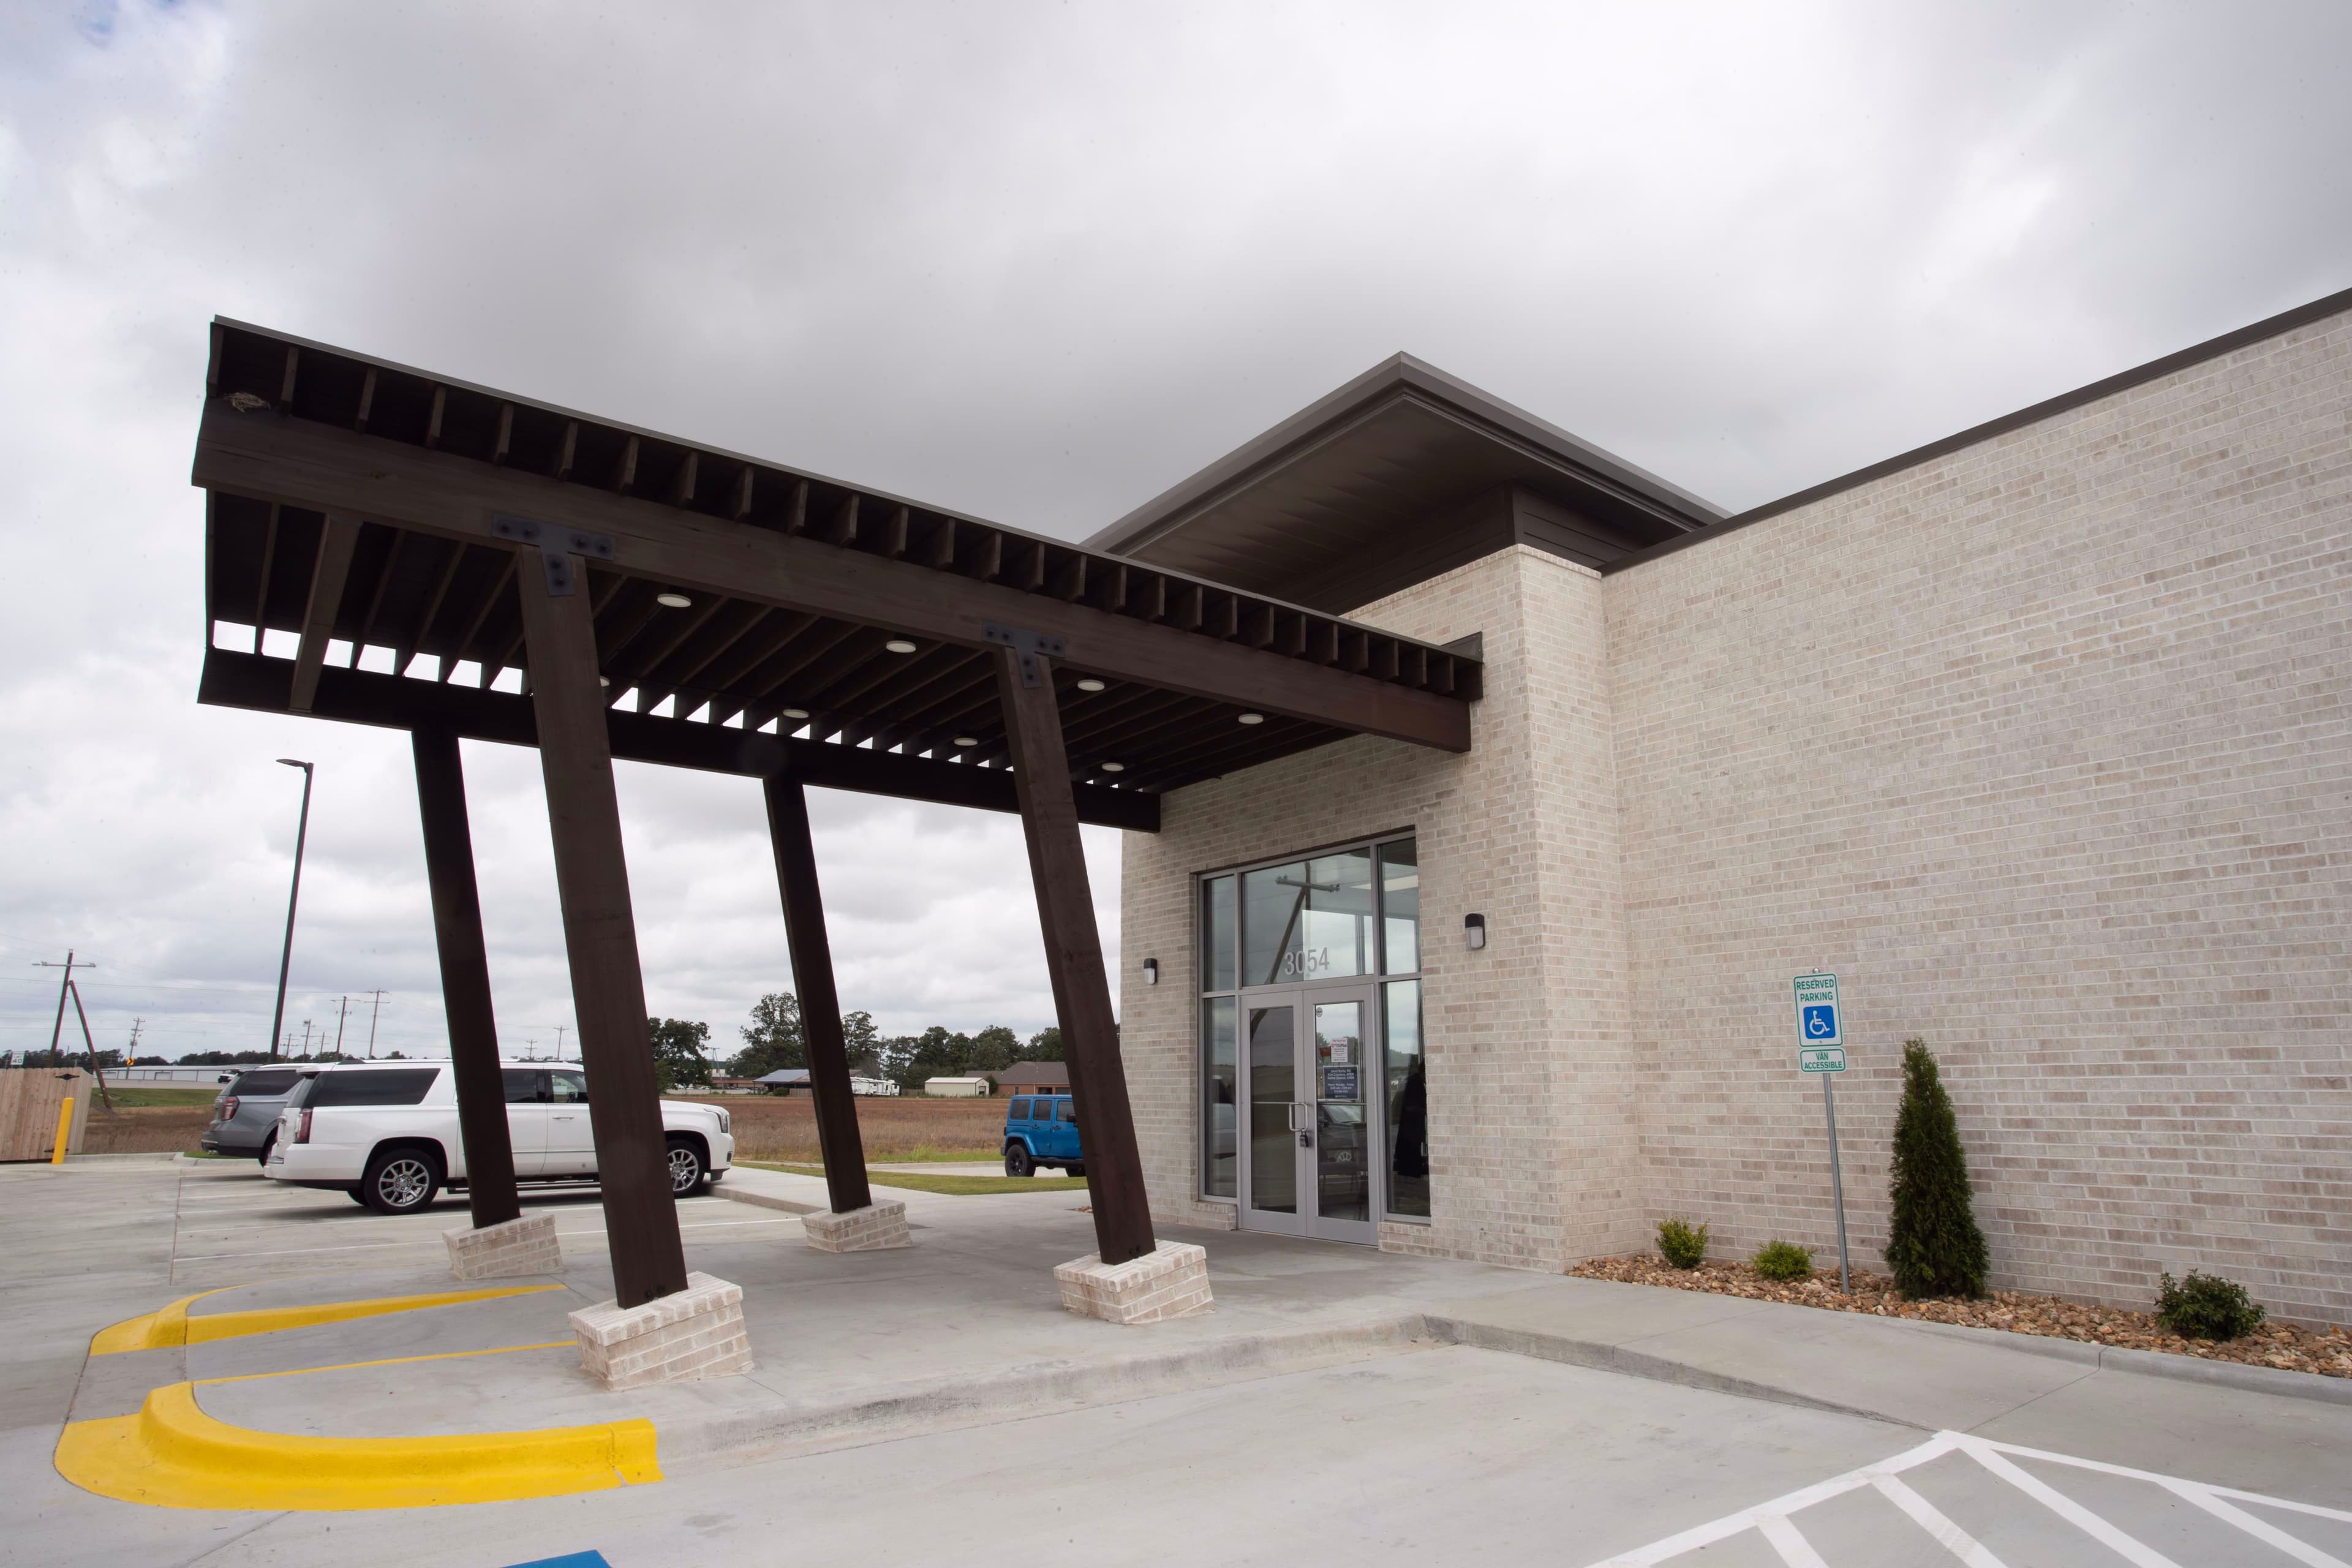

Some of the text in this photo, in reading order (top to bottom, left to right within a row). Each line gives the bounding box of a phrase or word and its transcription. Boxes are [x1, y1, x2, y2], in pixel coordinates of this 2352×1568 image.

[1284, 947, 1330, 975] 3054
[1796, 979, 1834, 990] RESERVED
[1800, 992, 1833, 1002] PARKING
[1815, 1052, 1829, 1061] VAN
